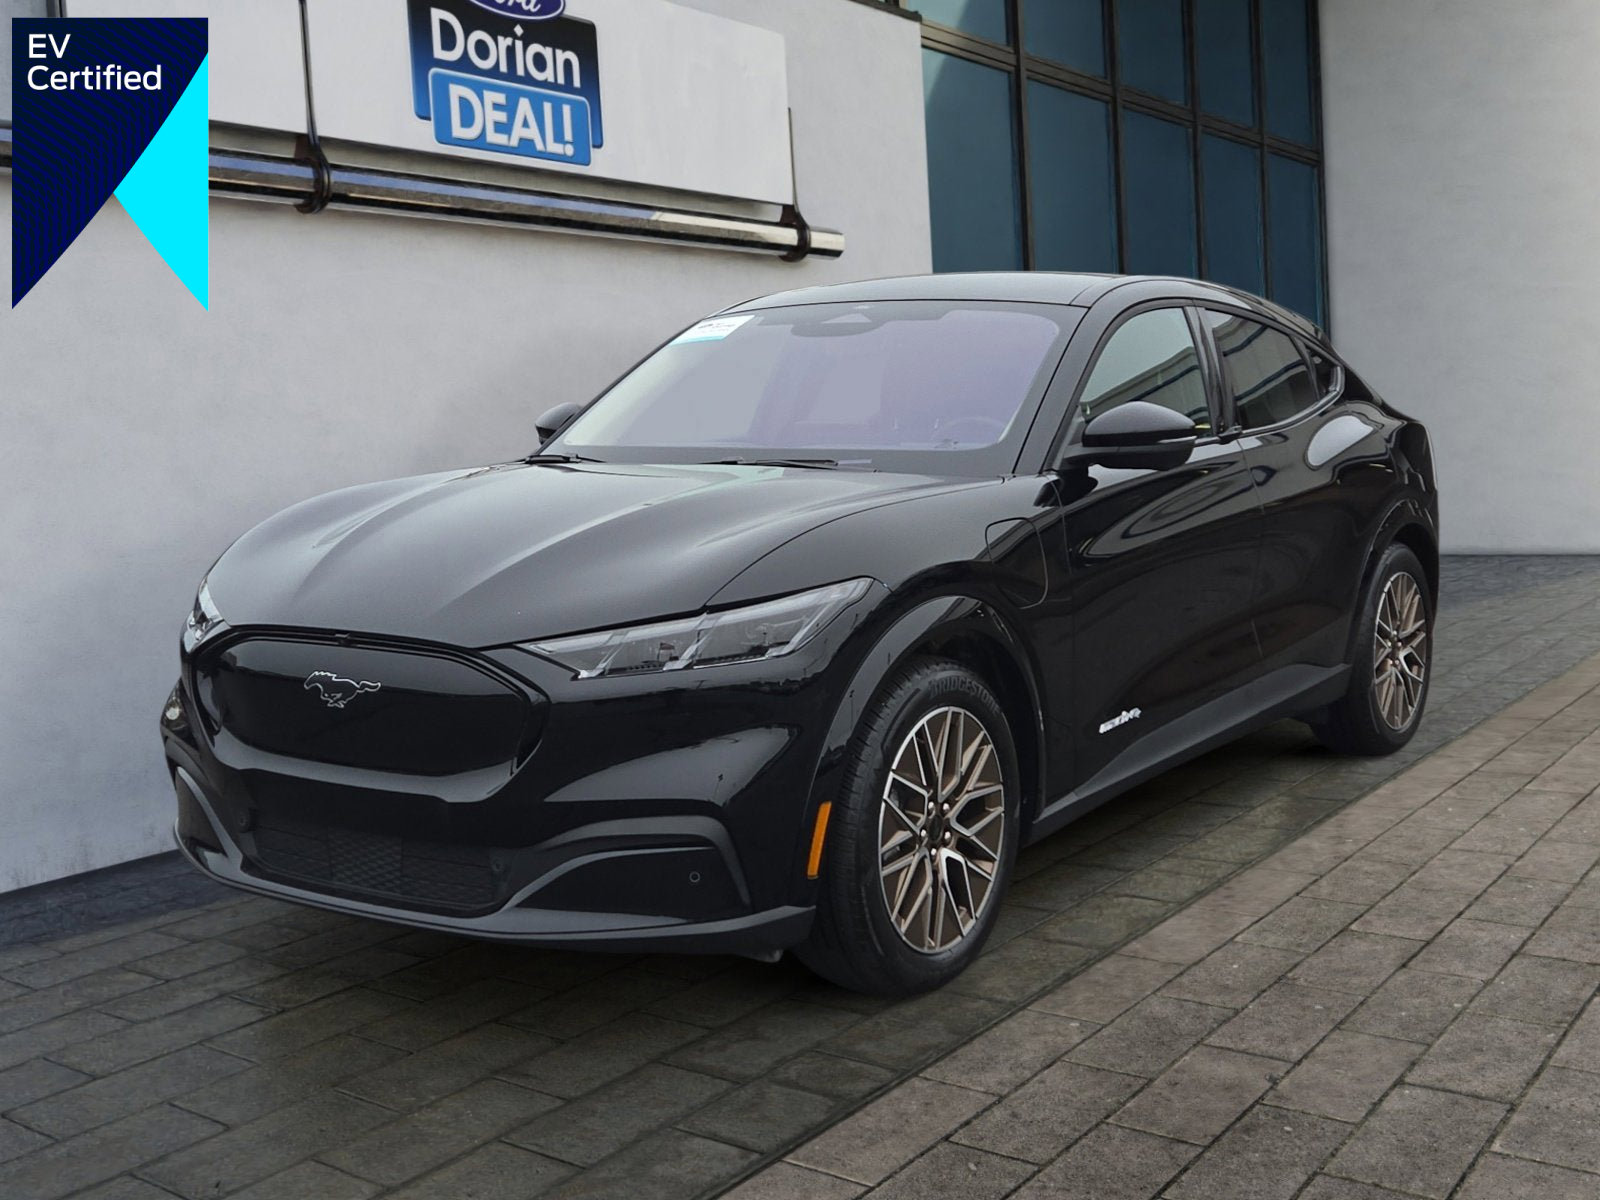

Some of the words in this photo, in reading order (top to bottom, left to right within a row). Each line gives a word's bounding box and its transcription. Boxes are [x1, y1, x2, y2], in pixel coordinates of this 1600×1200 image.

[430, 7, 581, 88] Dorian
[449, 83, 575, 157] DEAL!
[927, 675, 1000, 718] BRIDGESTONE
